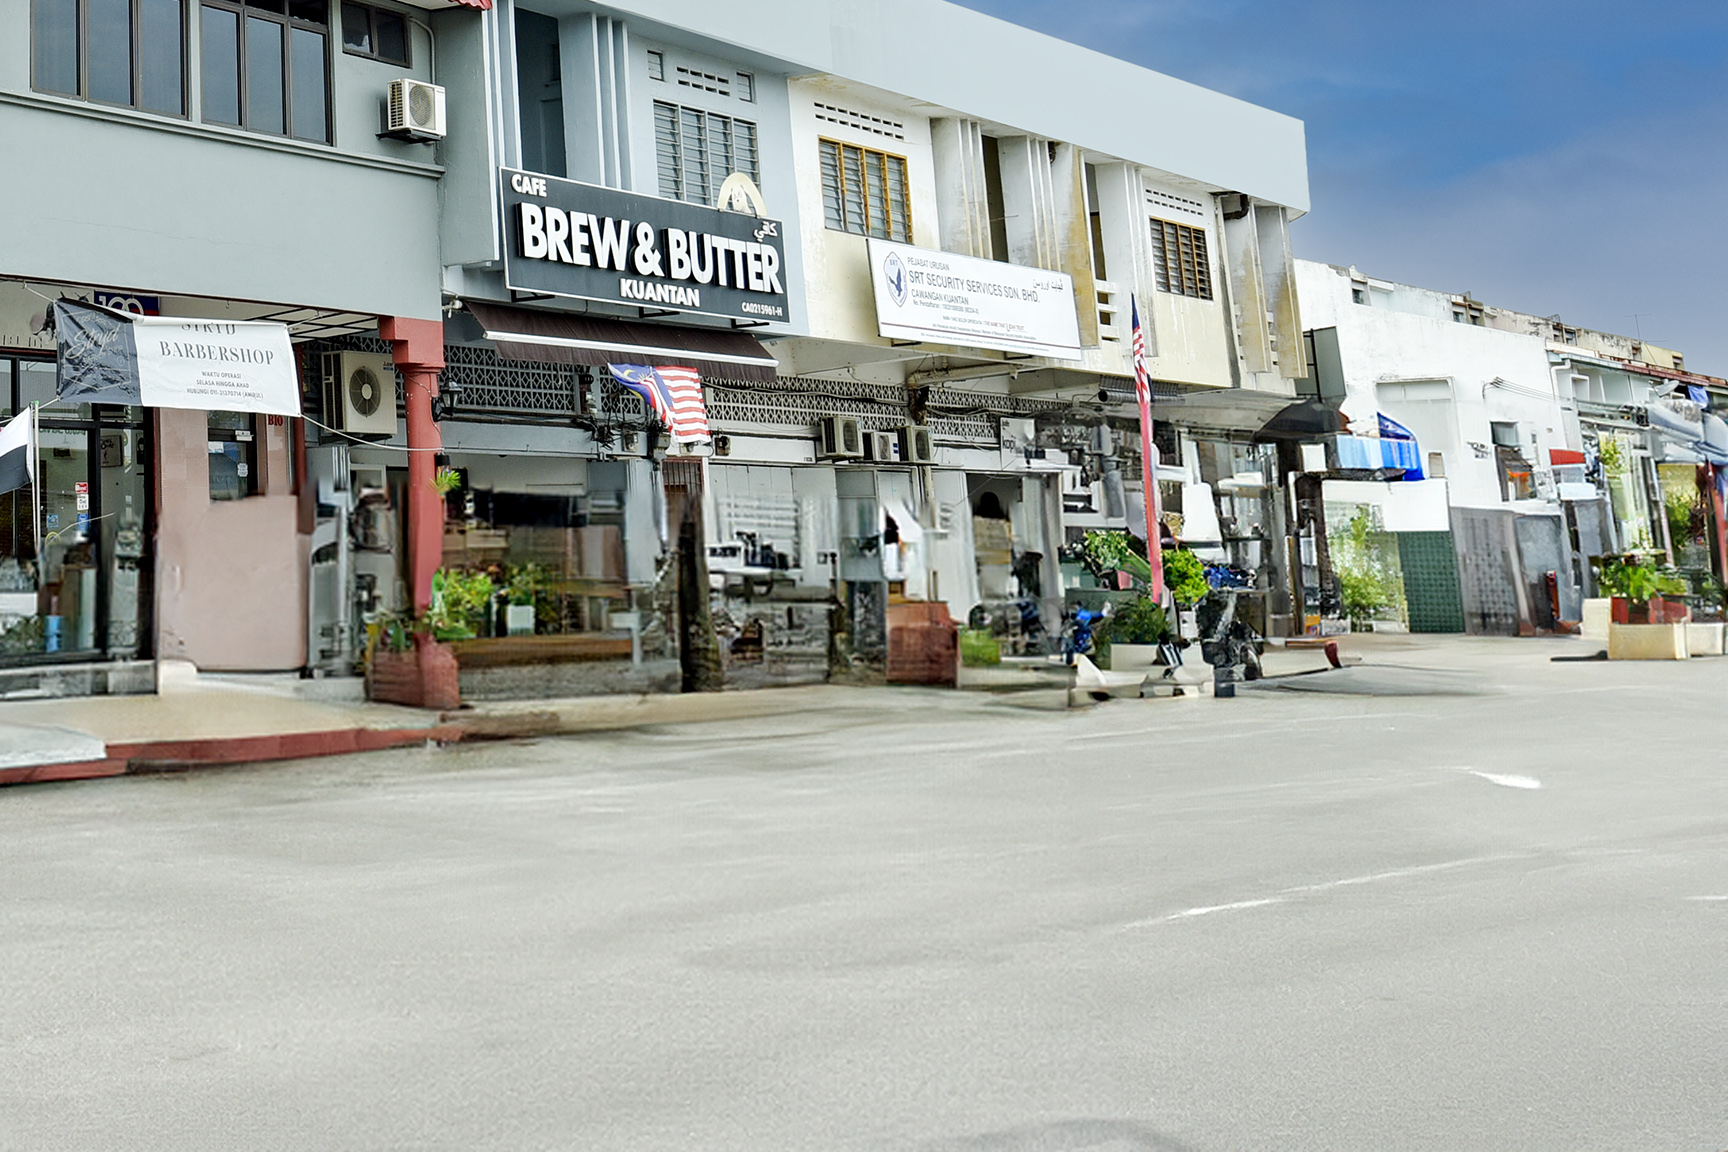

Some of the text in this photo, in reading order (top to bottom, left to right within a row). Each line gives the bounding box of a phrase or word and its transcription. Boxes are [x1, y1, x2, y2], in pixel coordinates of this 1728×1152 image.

[511, 174, 547, 197] CAFE
[620, 278, 700, 307] KUANTAN
[909, 270, 925, 285] SRT
[926, 273, 965, 291] SECURITY
[966, 280, 1003, 297] SERVICES
[159, 340, 274, 366] BARBERSHOP
